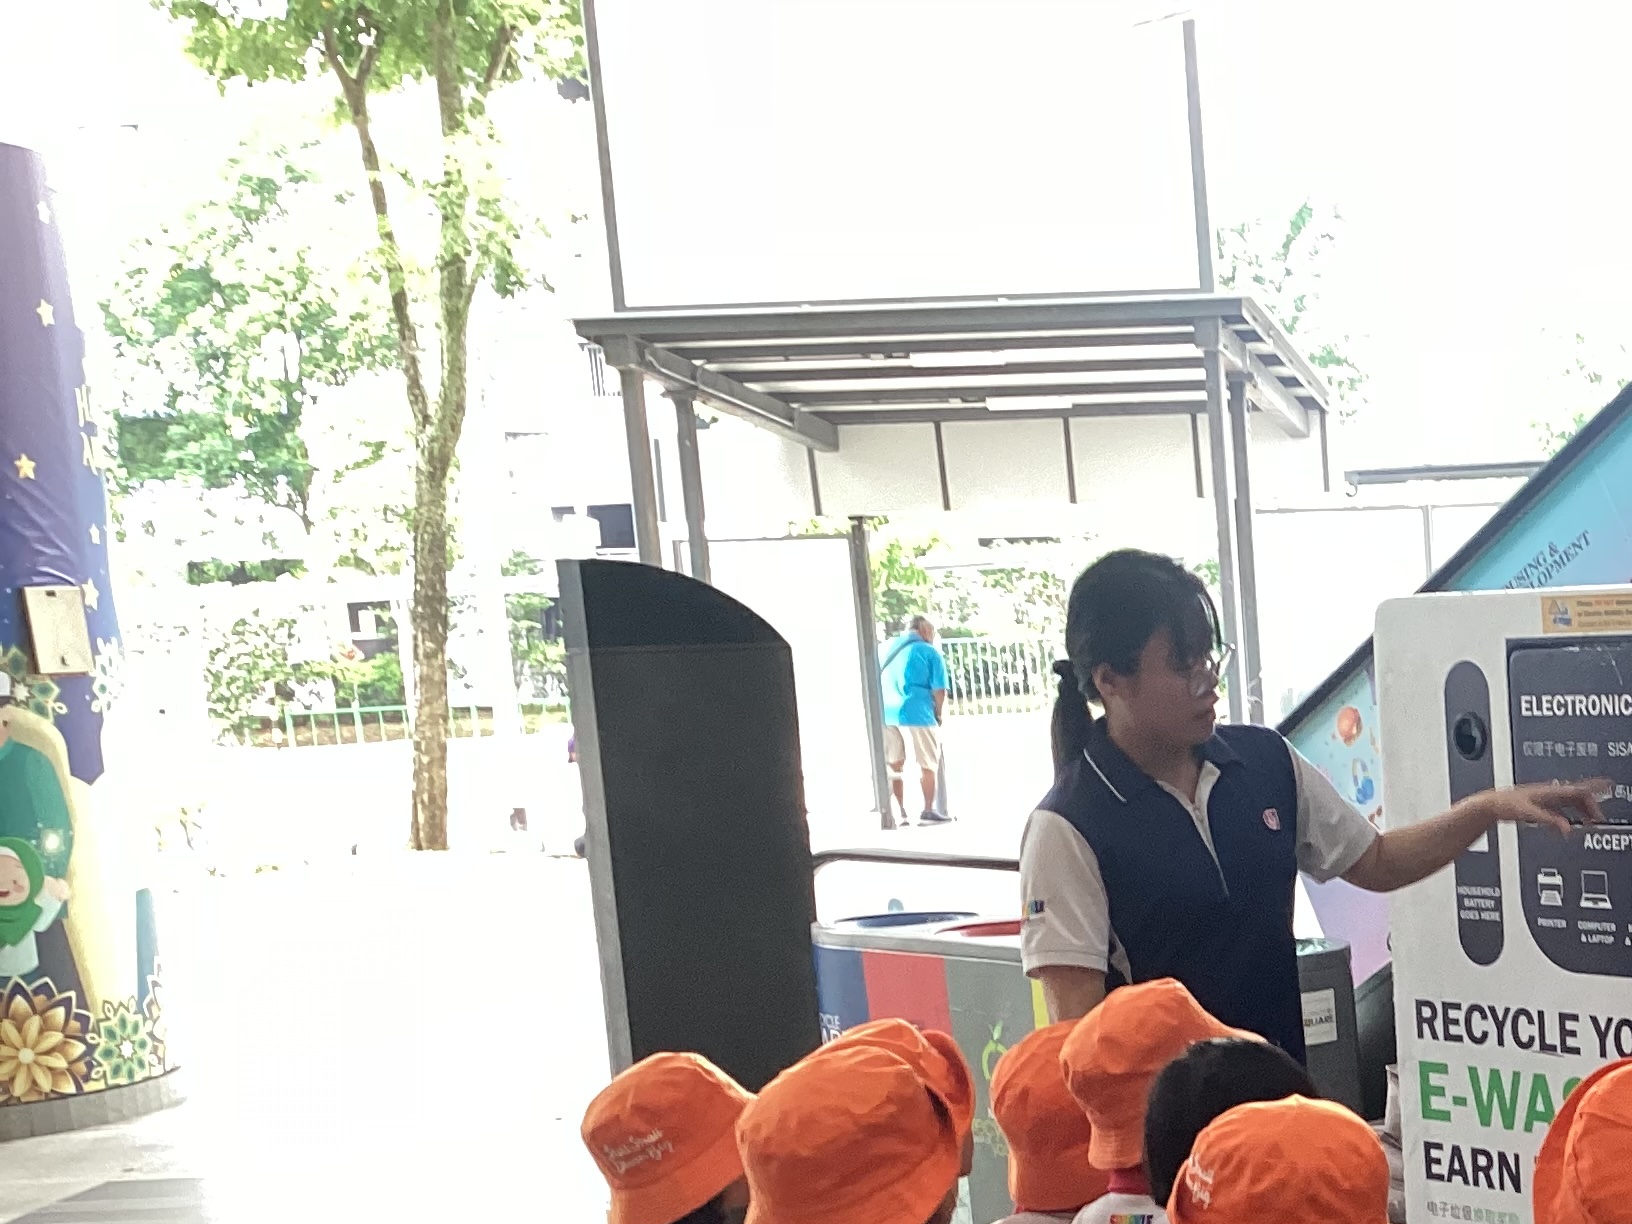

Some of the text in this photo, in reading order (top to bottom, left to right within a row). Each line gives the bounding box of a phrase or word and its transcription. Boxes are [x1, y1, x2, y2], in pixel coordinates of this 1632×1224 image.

[1520, 693, 1632, 716] ELECTRONIC
[1537, 917, 1567, 928] PRINTER
[1577, 920, 1616, 933] COMPUTER
[1588, 934, 1614, 944] LAPTOP
[1414, 998, 1581, 1056] RECYCLE
[1423, 1141, 1522, 1193] EARN
